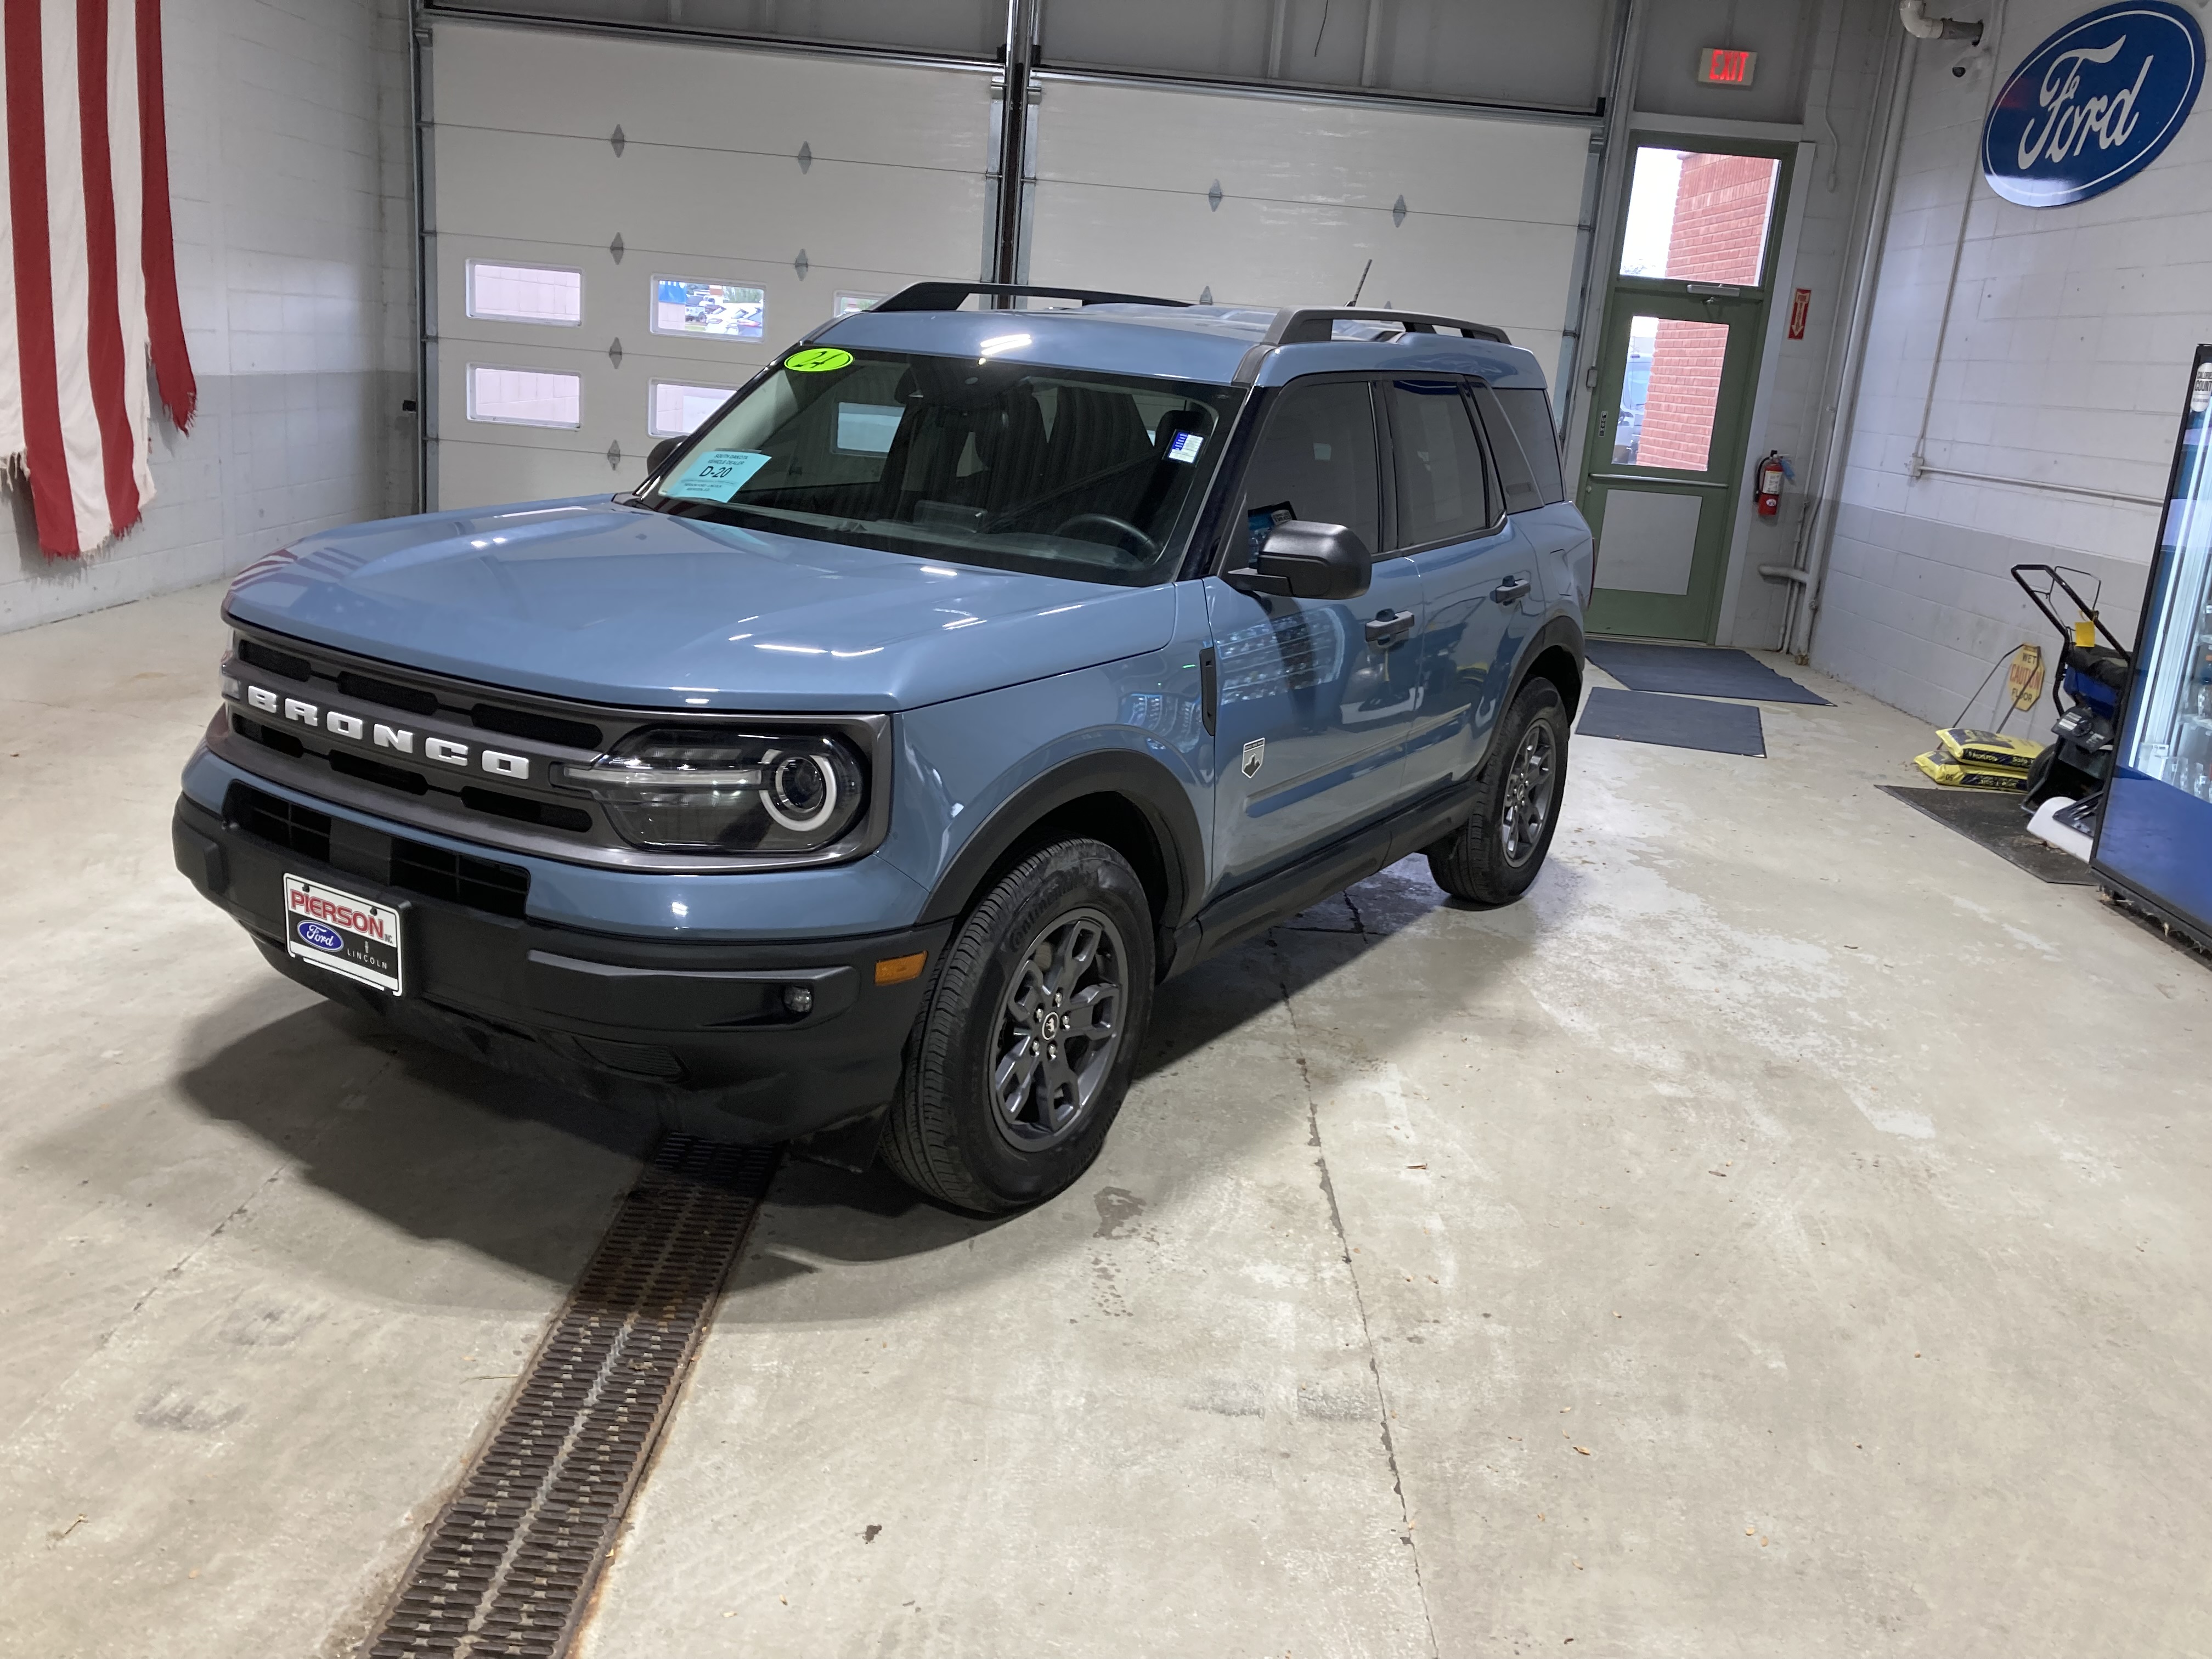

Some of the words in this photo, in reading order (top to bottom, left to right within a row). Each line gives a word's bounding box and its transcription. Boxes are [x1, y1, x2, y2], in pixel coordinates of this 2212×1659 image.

[1709, 49, 1748, 81] EXIT
[2018, 34, 2154, 170] Ford
[792, 351, 844, 369] 24
[698, 466, 732, 478] D-20
[2022, 653, 2037, 664] WET
[247, 685, 529, 780] BRONCO
[290, 889, 384, 940] PIERSON
[384, 933, 394, 944] INC.
[306, 924, 334, 947] Ford
[347, 948, 387, 970] LINCOLN
